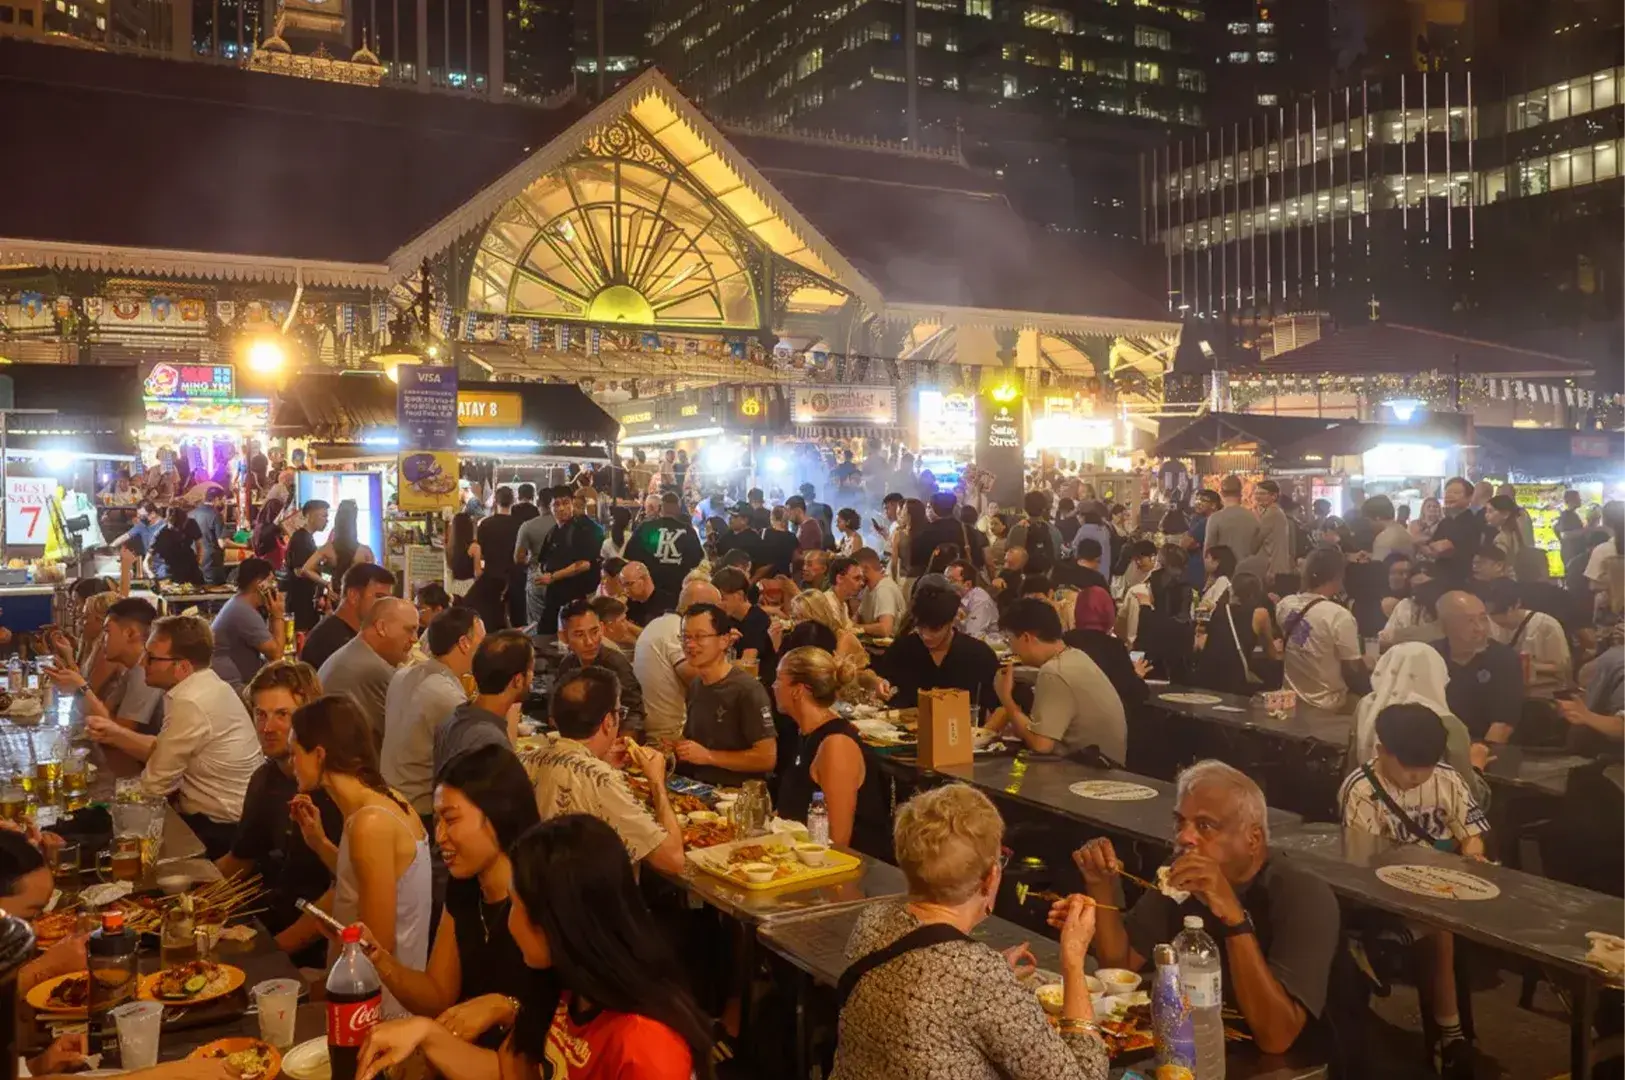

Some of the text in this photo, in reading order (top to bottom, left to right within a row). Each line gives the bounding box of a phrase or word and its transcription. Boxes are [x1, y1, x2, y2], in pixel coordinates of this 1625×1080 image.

[417, 372, 442, 383] VISA
[457, 401, 485, 416] ATAY
[489, 401, 498, 417] 8
[990, 423, 1016, 438] Satay
[989, 435, 1020, 447] Street
[20, 506, 41, 539] 7
